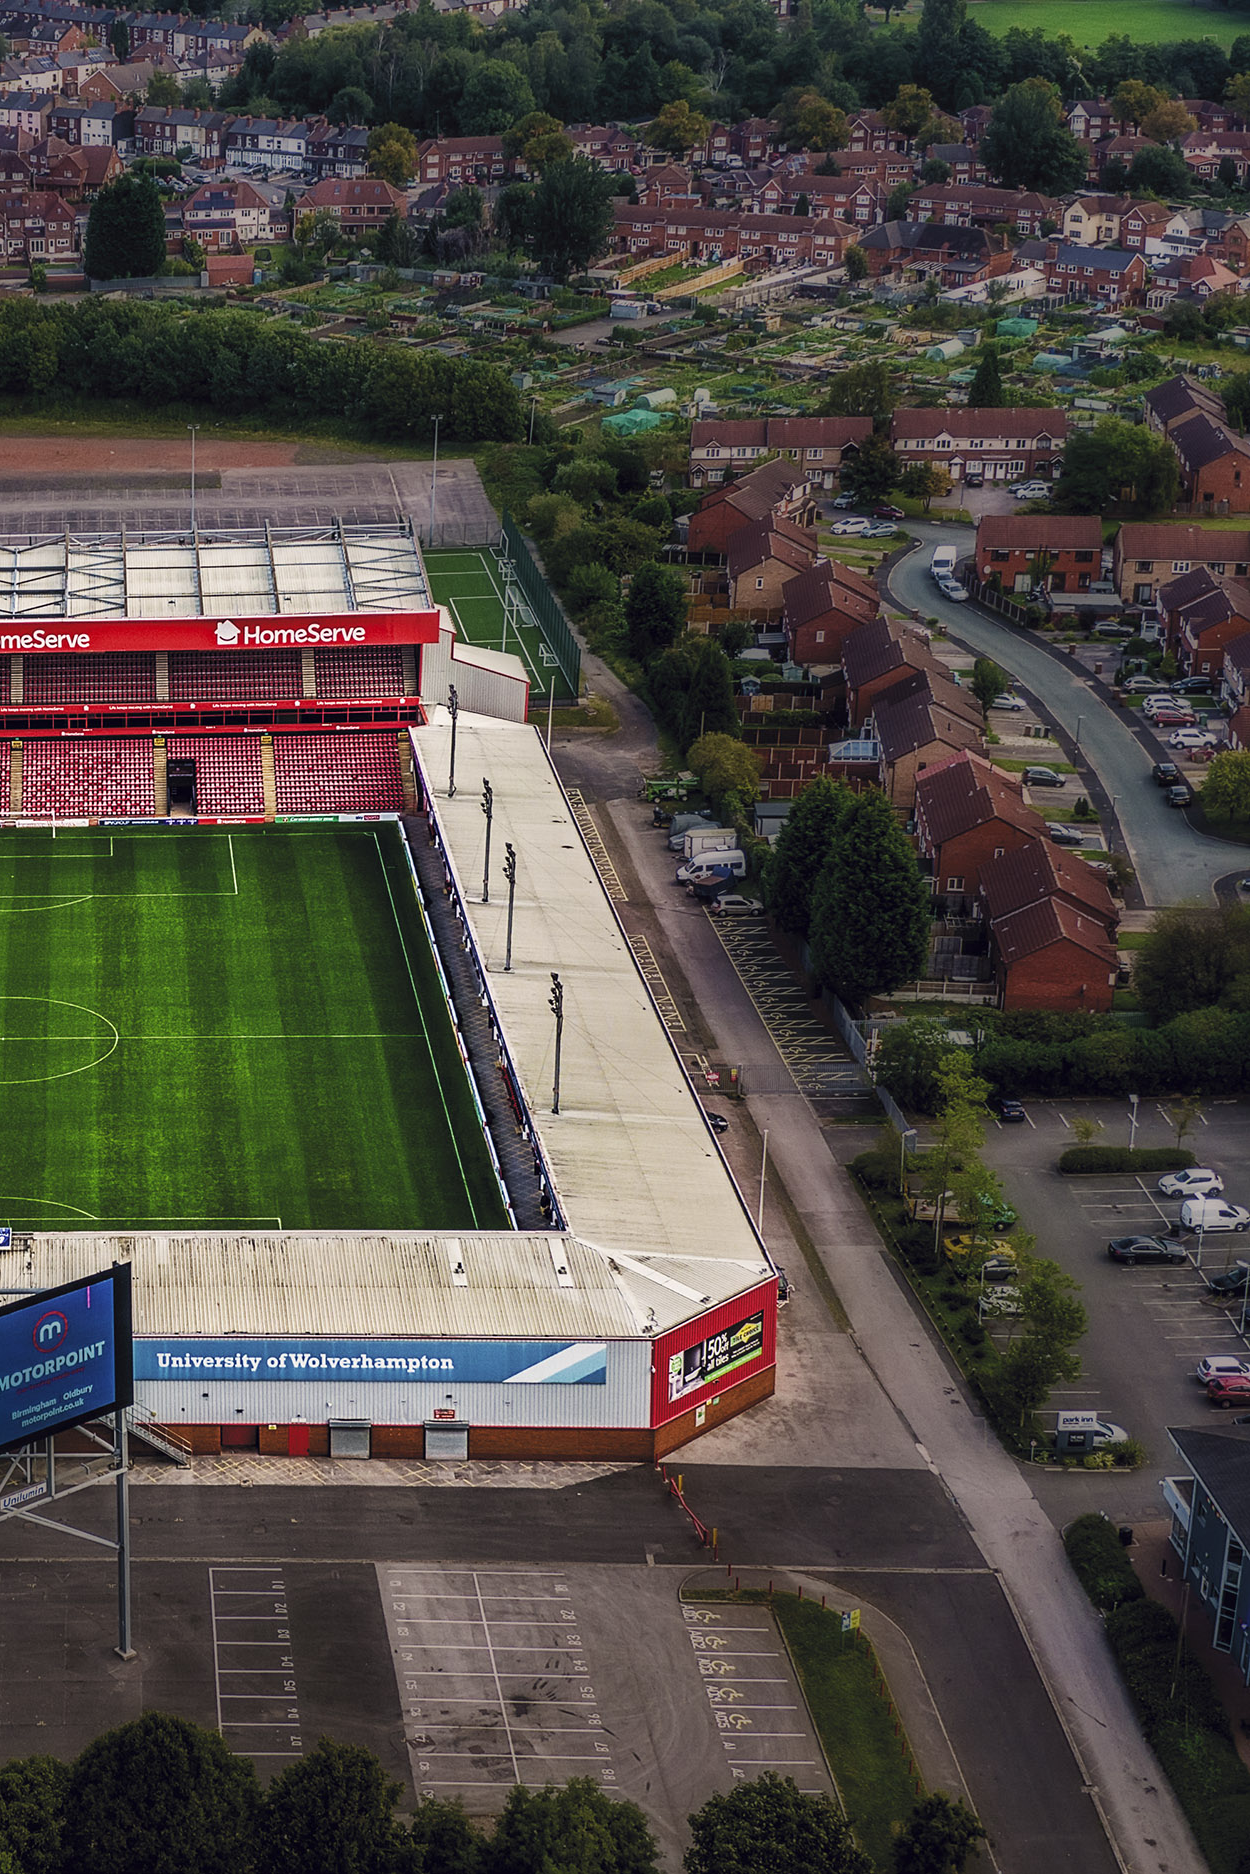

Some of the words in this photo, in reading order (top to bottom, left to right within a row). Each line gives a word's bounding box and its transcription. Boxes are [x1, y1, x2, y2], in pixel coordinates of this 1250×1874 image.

[244, 623, 365, 645] HomeServe
[157, 1352, 262, 1372] University
[266, 1352, 288, 1368] of
[288, 1353, 454, 1373] Wolverhampton
[12, 1398, 56, 1420] Birmingham
[63, 1384, 93, 1401] Oldbury
[22, 1398, 84, 1428] motorpoint.co.uk
[3, 1486, 44, 1508] Unilumin
[272, 1580, 286, 1590] D1
[274, 1603, 288, 1614] D2
[278, 1629, 290, 1639] D3
[281, 1656, 294, 1667] D4
[284, 1679, 296, 1691] D5
[288, 1707, 300, 1719] D6
[290, 1735, 302, 1747] D7
[731, 1767, 745, 1778] A2
